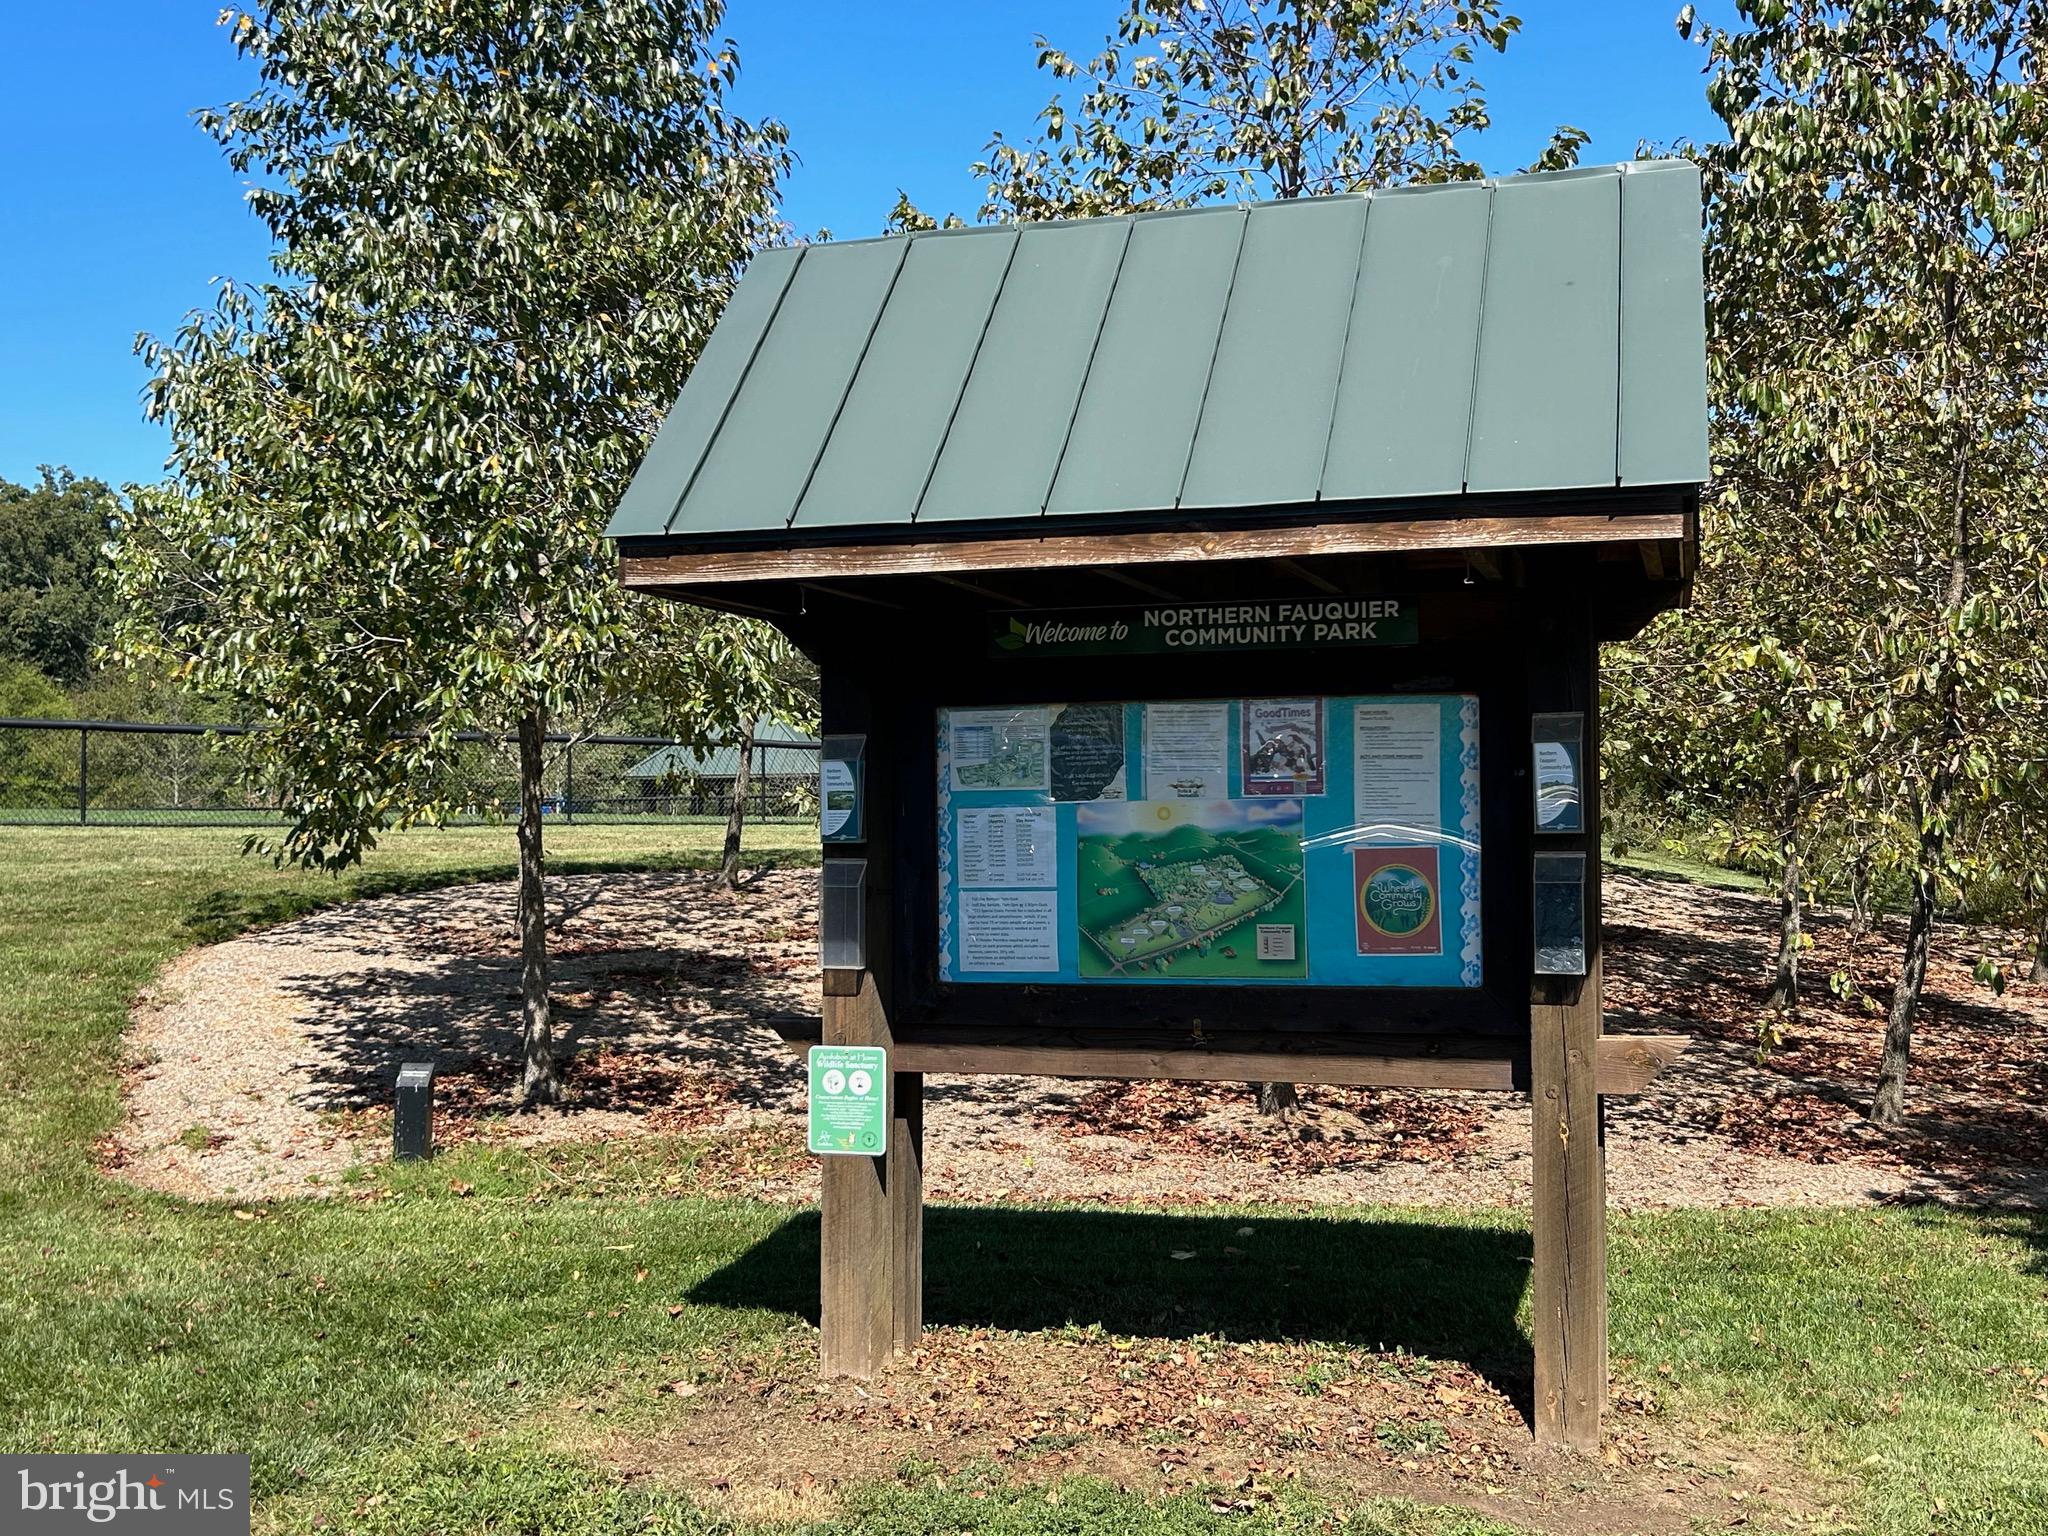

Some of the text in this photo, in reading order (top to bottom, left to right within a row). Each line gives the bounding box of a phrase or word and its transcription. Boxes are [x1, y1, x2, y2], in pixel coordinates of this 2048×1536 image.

[1143, 600, 1400, 627] NORTHERN FAUQUIER
[1025, 620, 1129, 645] Welcome to
[1164, 622, 1377, 647] COMMUNITY PARK
[1254, 707, 1312, 718] GoodTimes
[1370, 887, 1422, 903] Community
[1381, 899, 1417, 910] Grows
